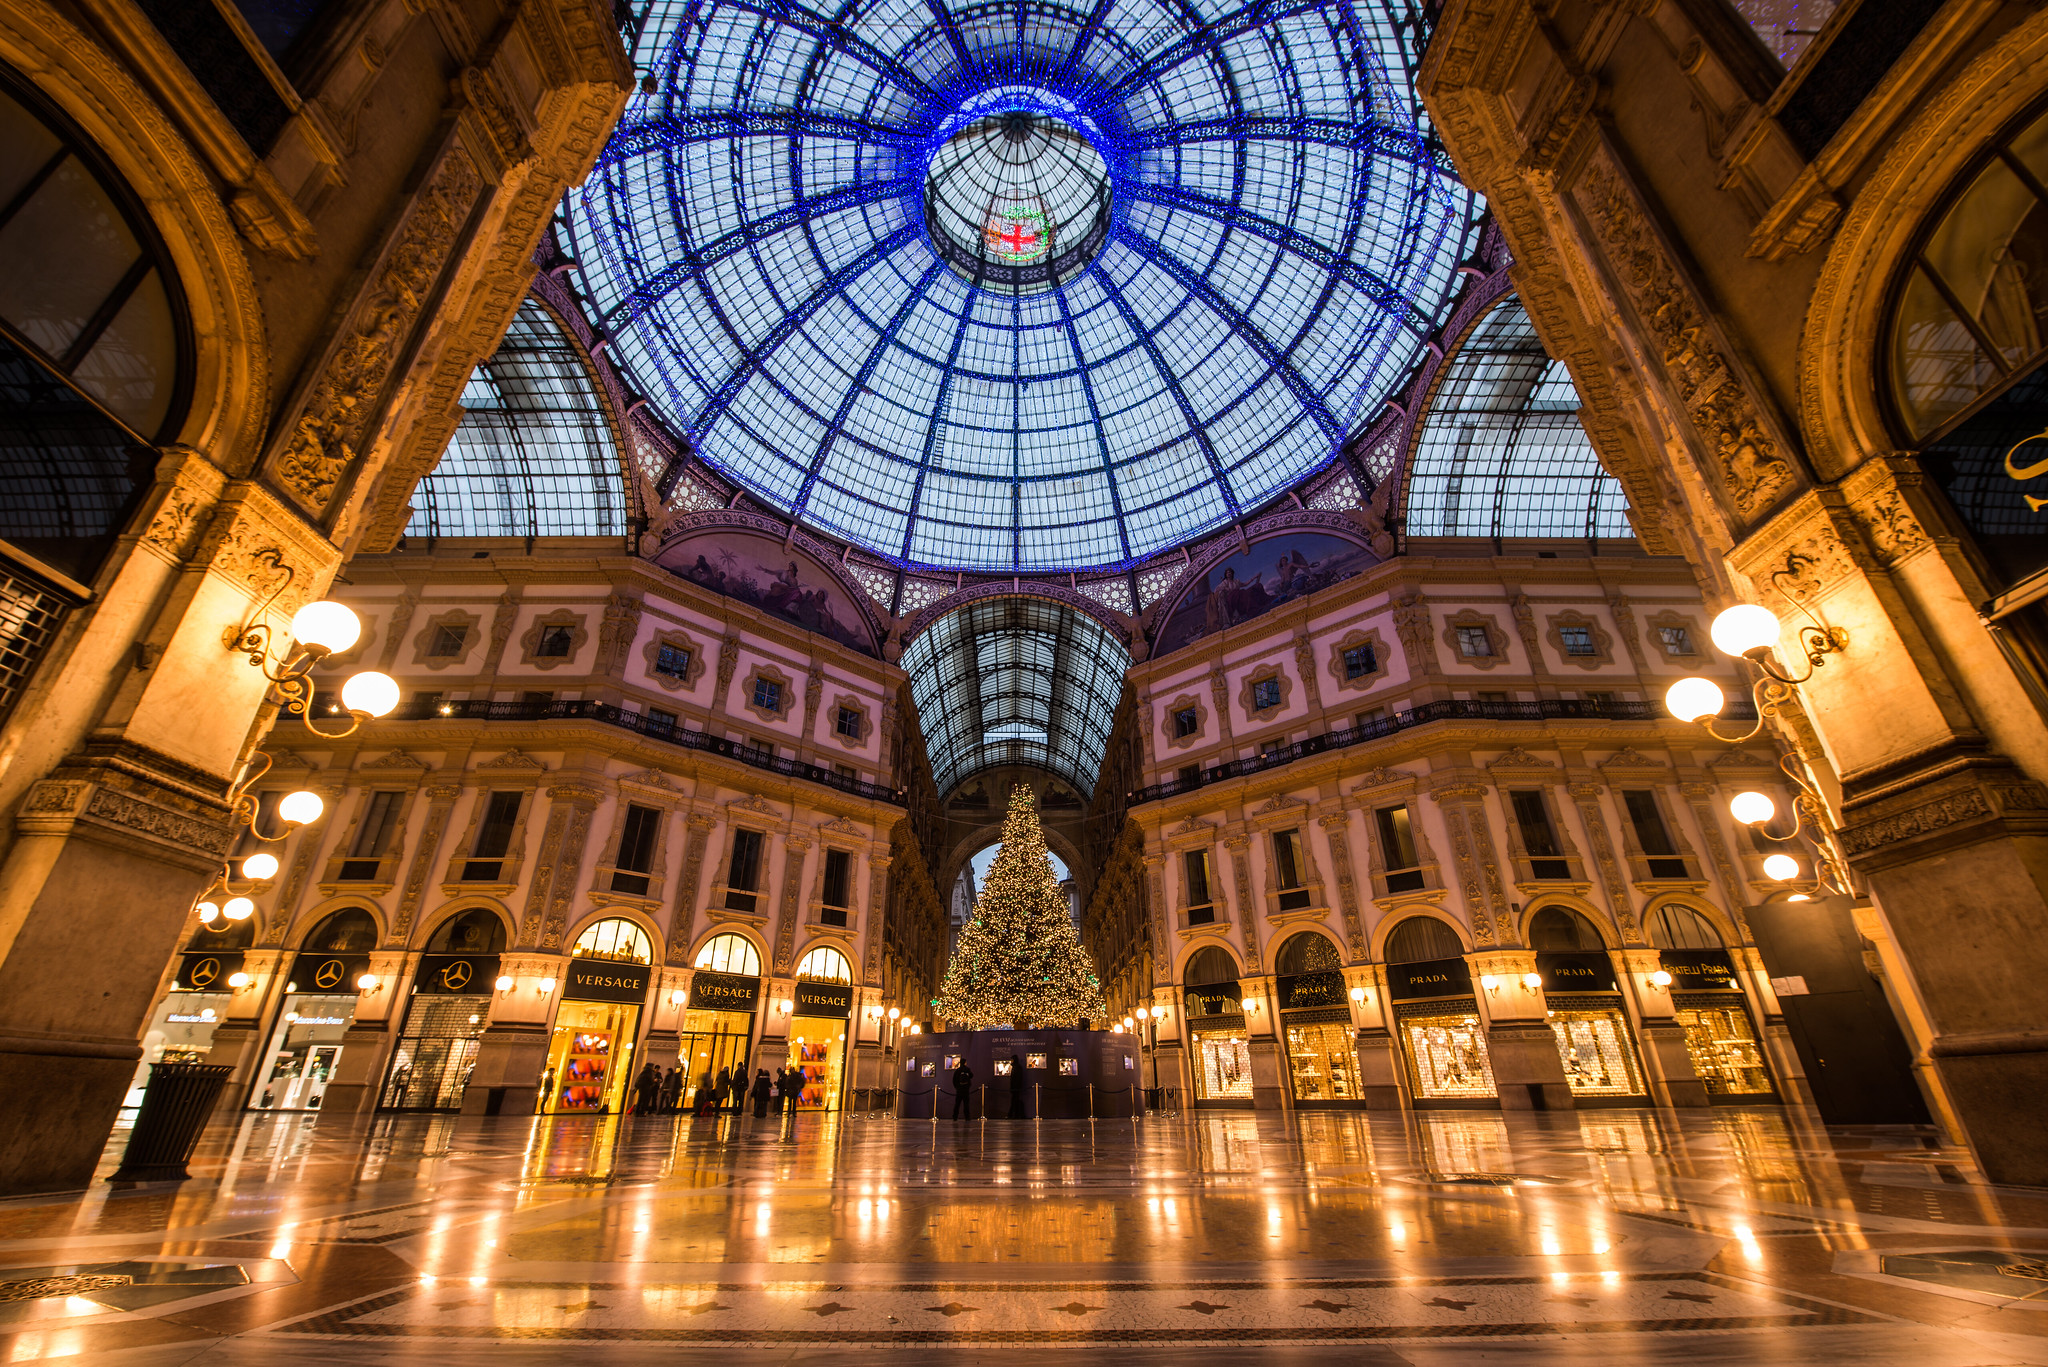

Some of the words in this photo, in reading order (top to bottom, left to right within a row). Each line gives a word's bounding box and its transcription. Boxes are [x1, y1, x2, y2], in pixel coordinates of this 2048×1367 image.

[1555, 968, 1595, 976] PRADA
[1663, 963, 1700, 975] FRATELLI
[1701, 963, 1730, 975] PRADA
[577, 974, 640, 989] VERSACE
[1410, 974, 1448, 984] PRADA
[700, 985, 752, 999] VERSACE
[1294, 986, 1327, 995] PRADA
[801, 994, 846, 1006] VERSACE
[1200, 995, 1227, 1003] PRADA
